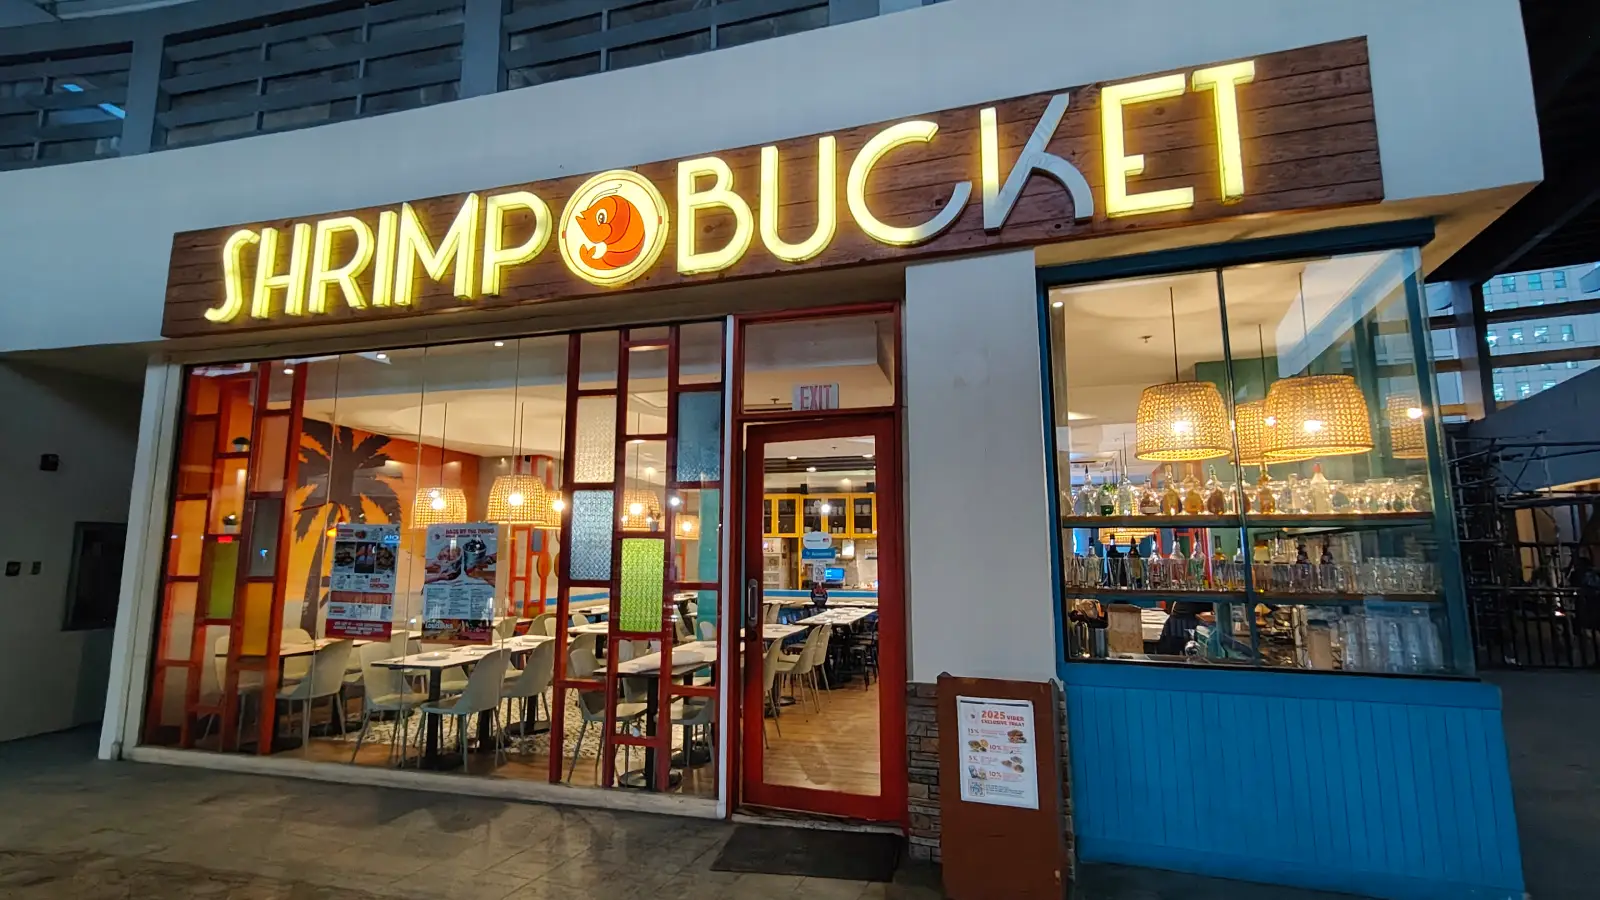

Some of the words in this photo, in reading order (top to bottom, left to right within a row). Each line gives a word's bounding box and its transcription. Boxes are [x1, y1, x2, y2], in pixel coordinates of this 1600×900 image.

[204, 191, 553, 323] SHRIMP
[676, 59, 1256, 275] BUCKET
[800, 384, 832, 410] EXIT
[981, 710, 1006, 720] 2025
